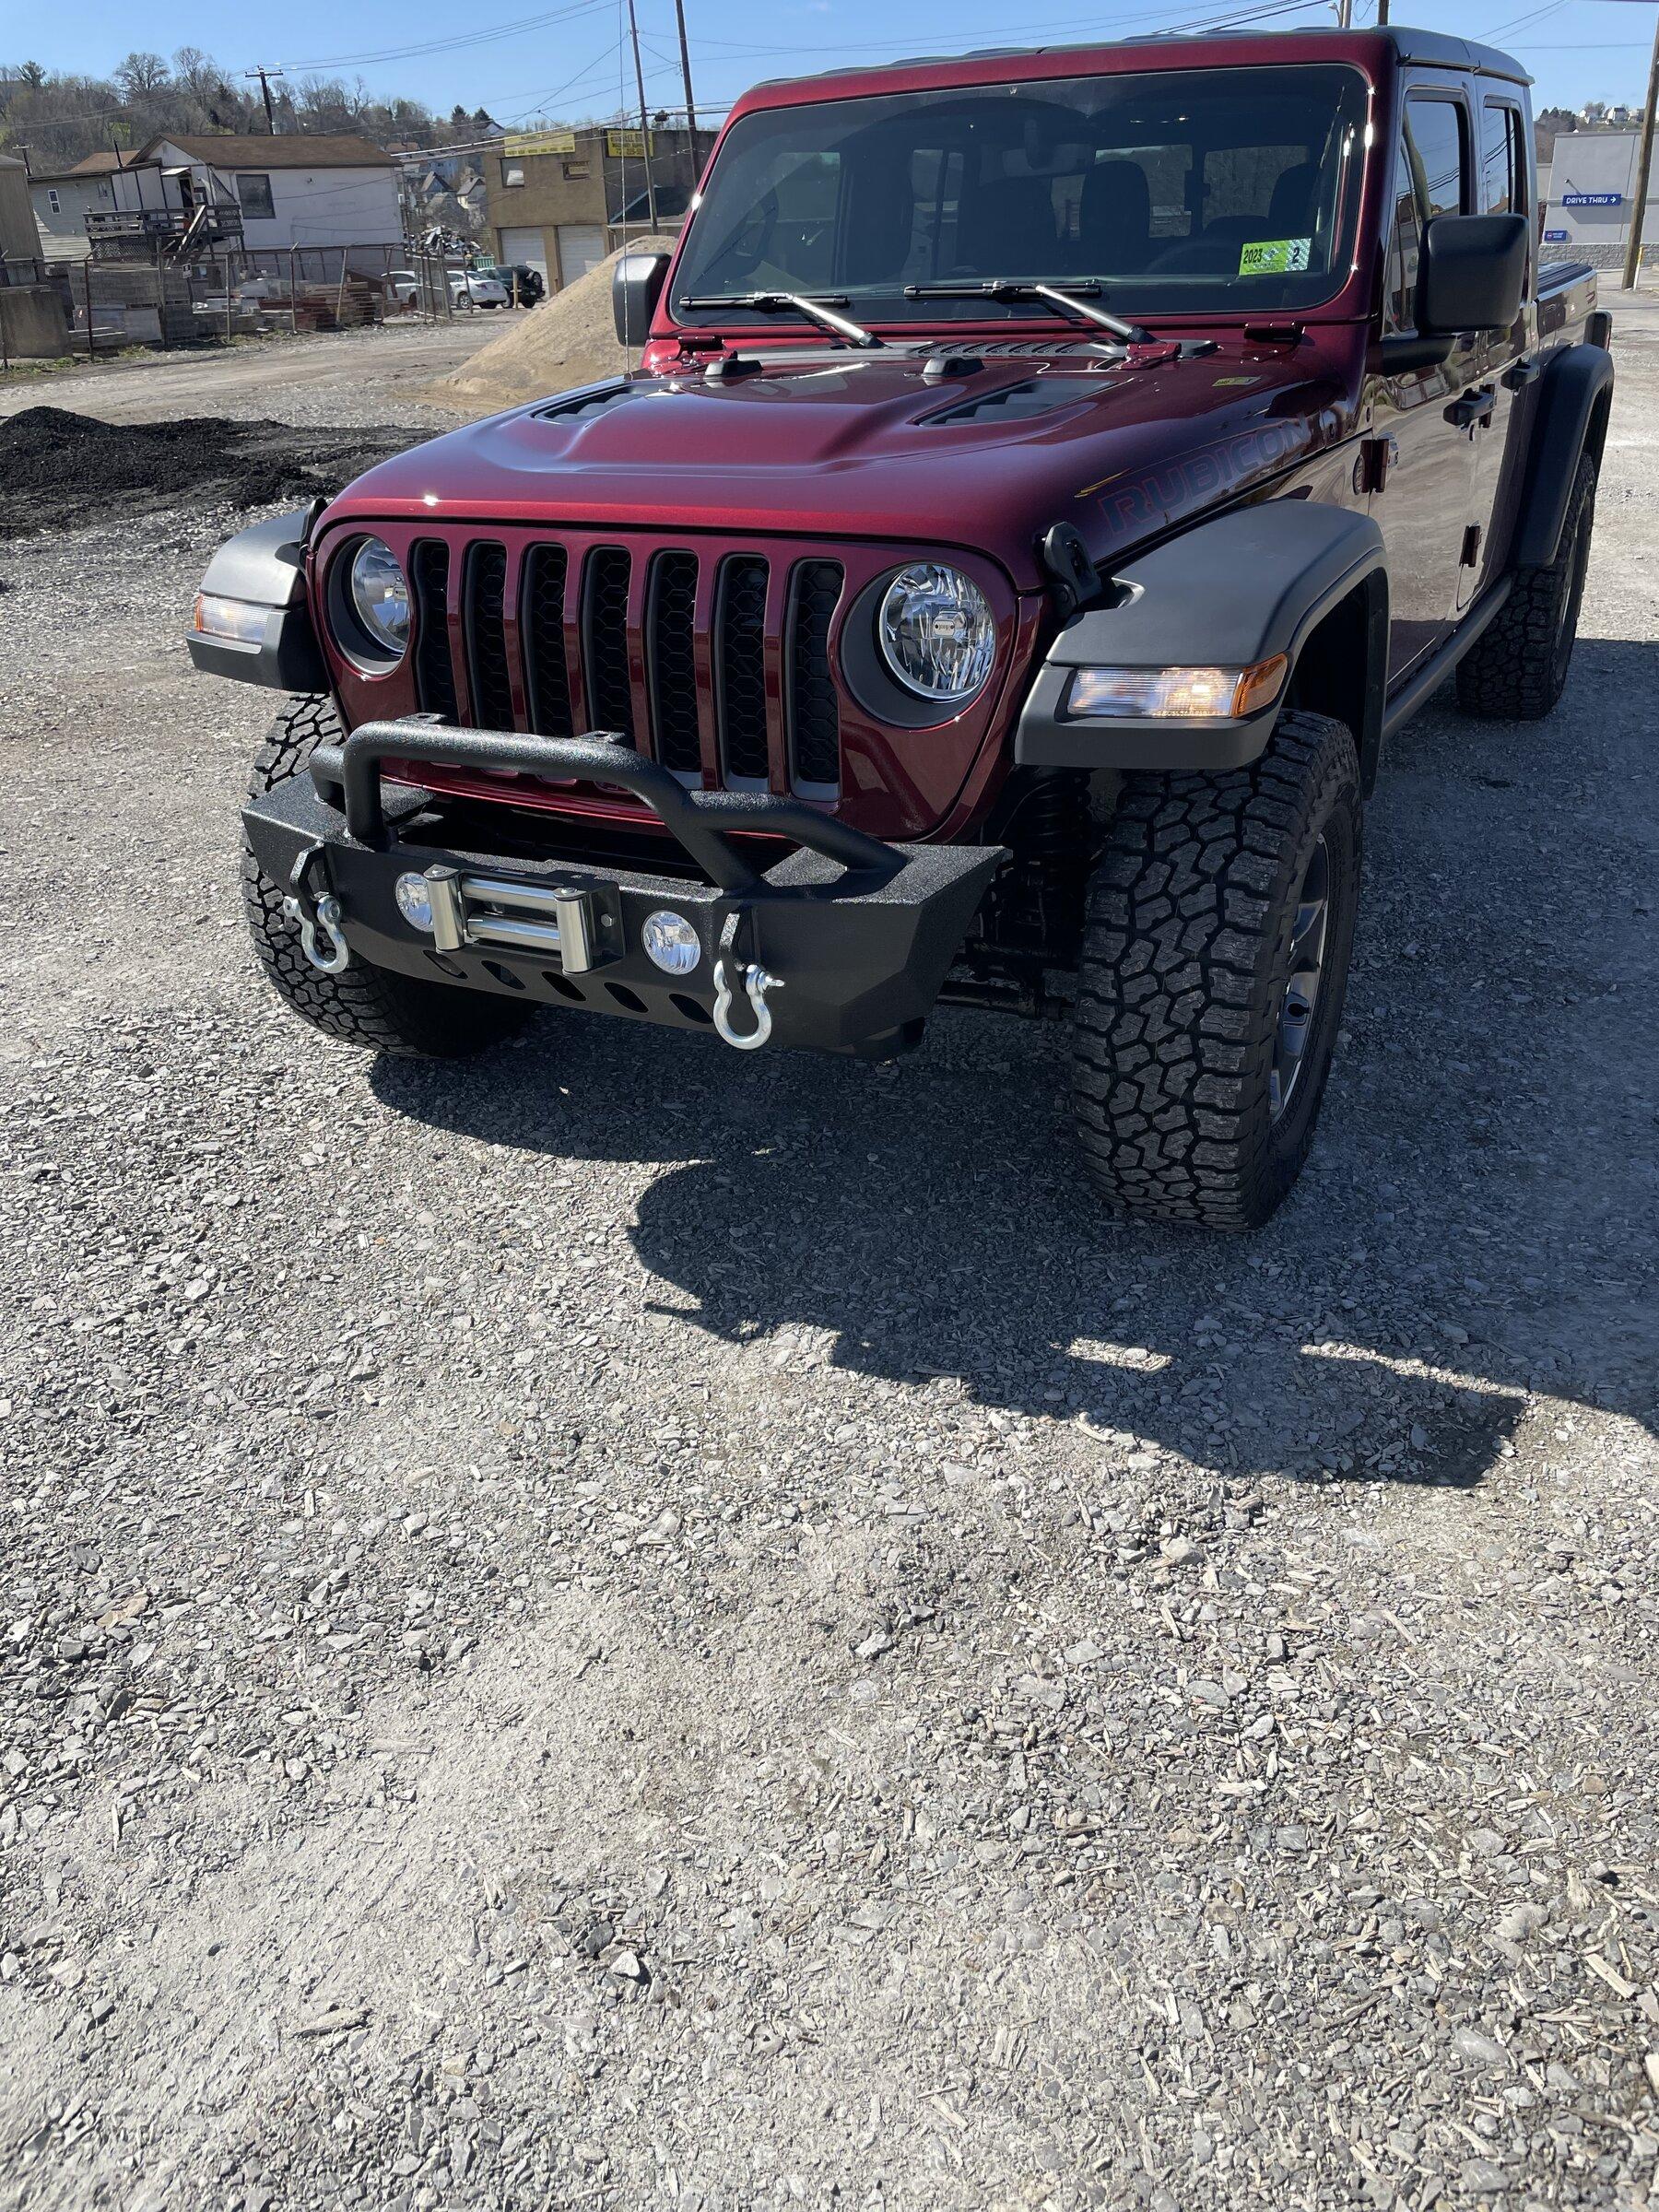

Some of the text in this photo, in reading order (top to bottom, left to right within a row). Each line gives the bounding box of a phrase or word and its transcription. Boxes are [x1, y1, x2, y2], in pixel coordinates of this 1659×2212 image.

[1242, 248, 1263, 264] 2023
[1292, 247, 1300, 263] 2
[1098, 413, 1312, 535] RUBICON
